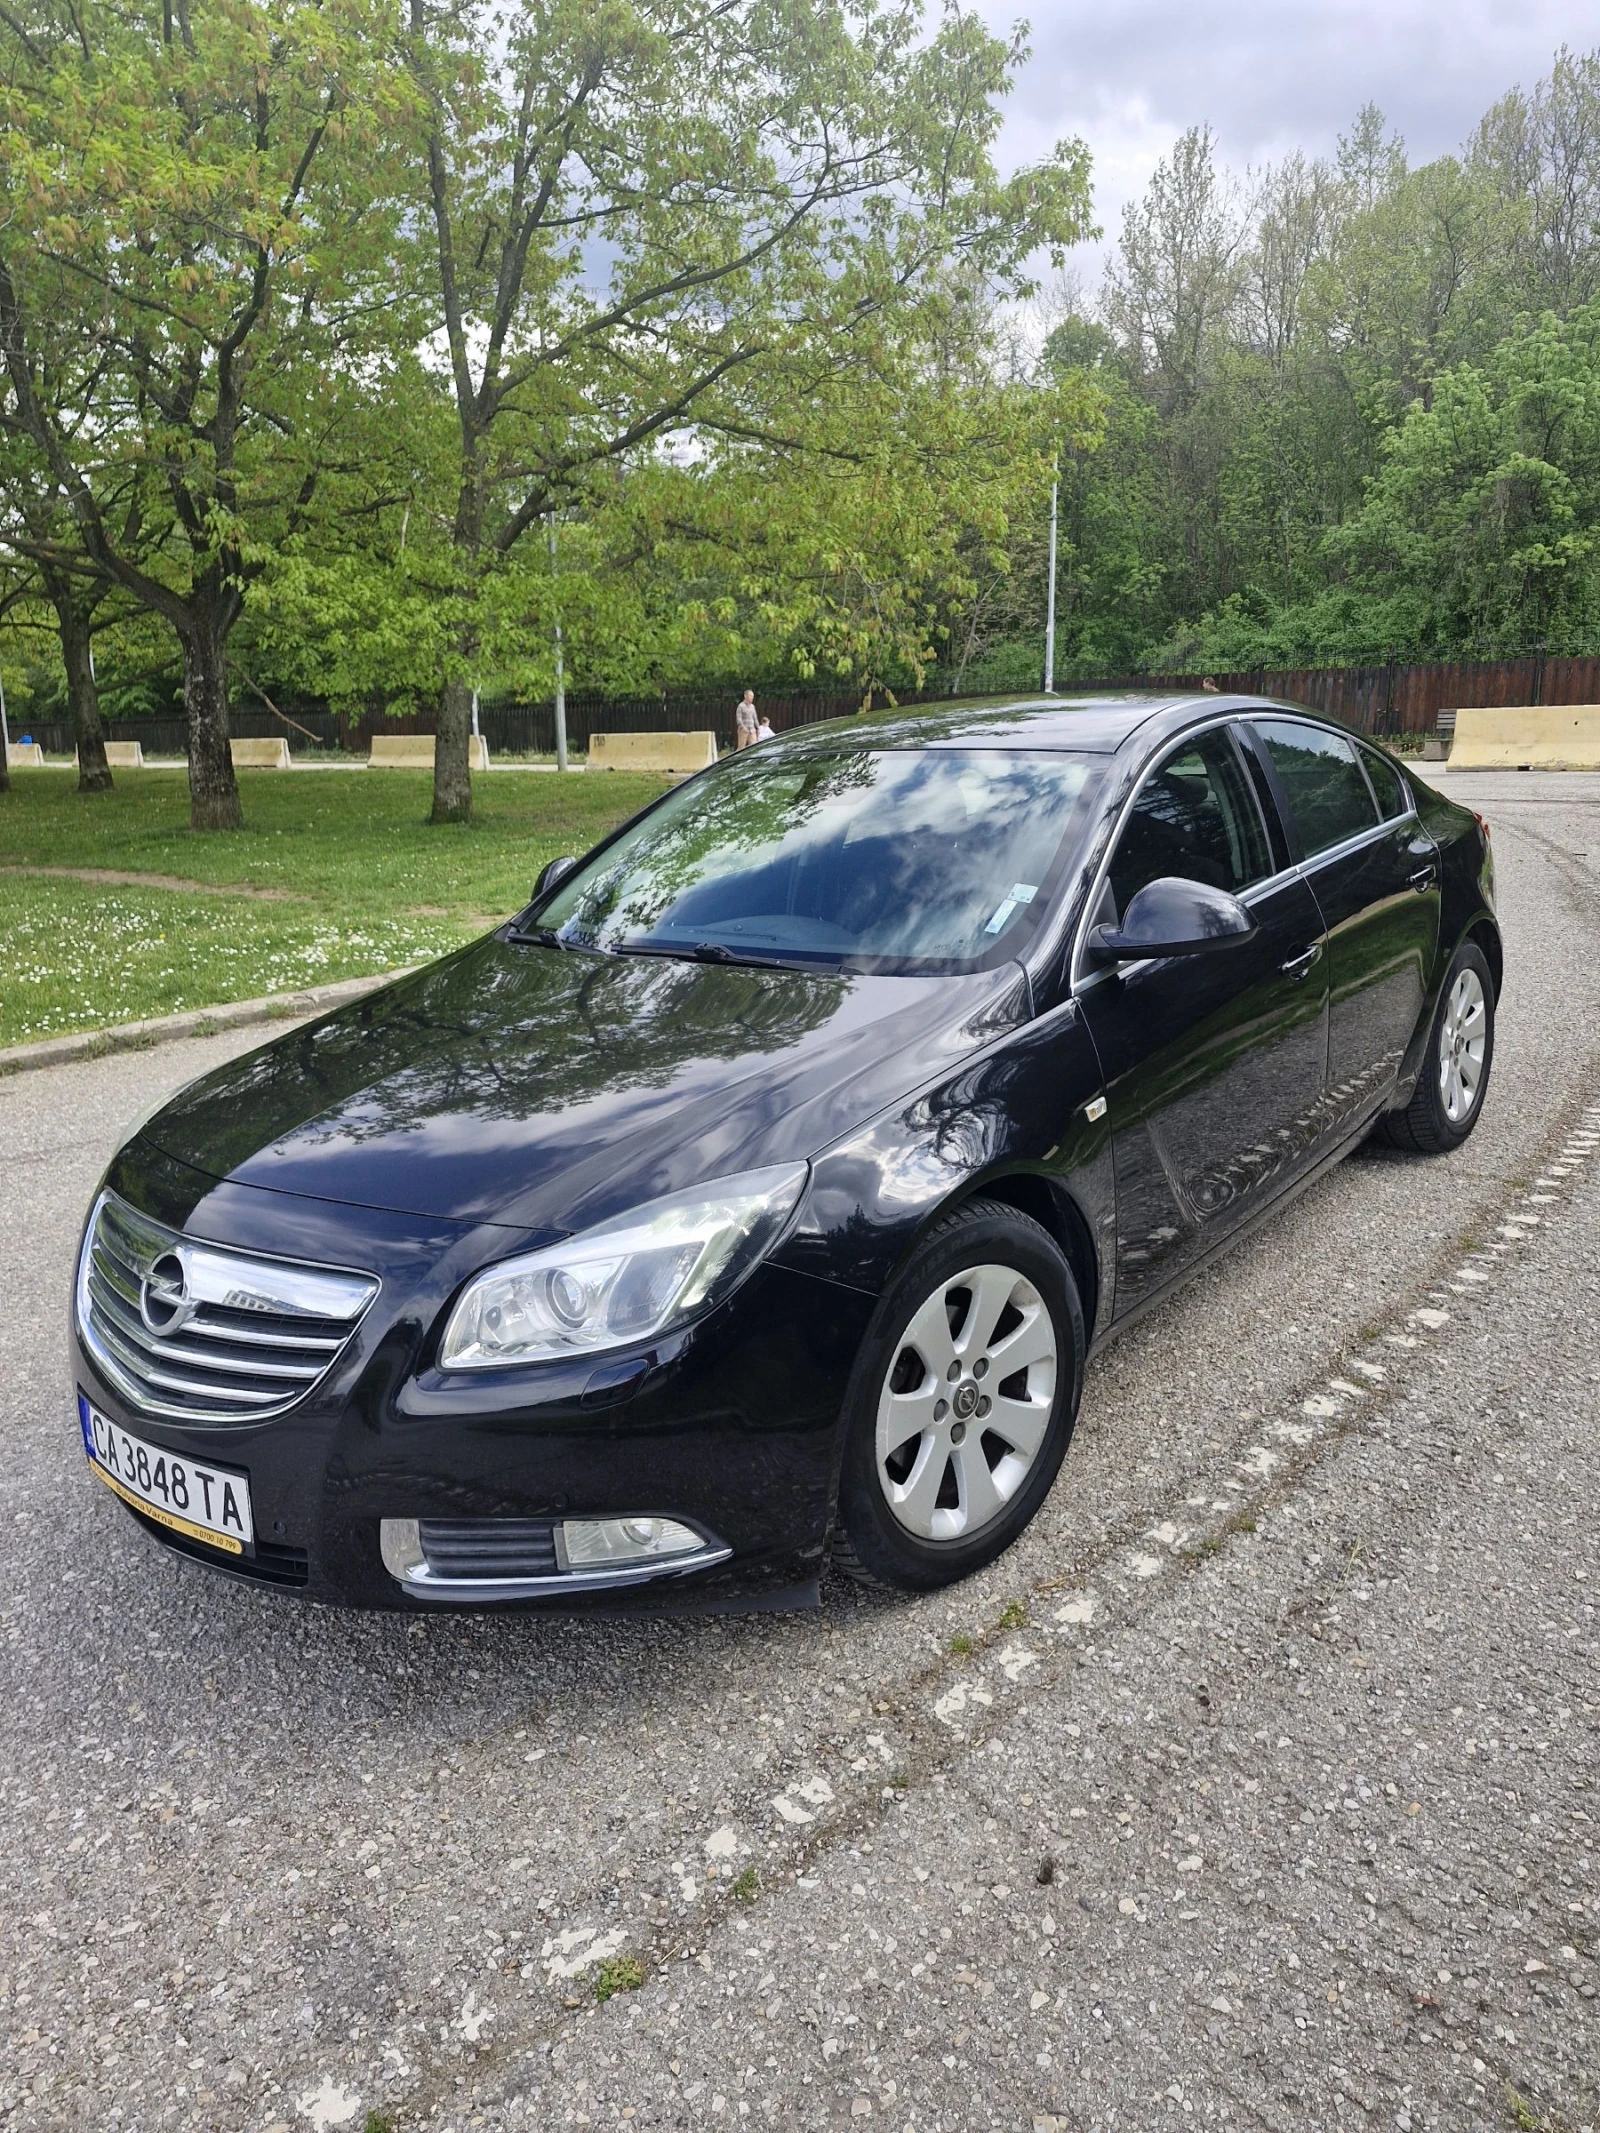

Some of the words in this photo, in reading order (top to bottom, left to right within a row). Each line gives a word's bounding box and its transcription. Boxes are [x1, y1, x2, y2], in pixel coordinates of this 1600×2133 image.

[92, 1414, 120, 1473] CA
[122, 1436, 189, 1510] 3848
[195, 1470, 244, 1532] TA
[146, 1505, 174, 1526] Varna
[199, 1529, 214, 1543] 0700
[216, 1535, 224, 1546] 10
[224, 1538, 237, 1550] 799
